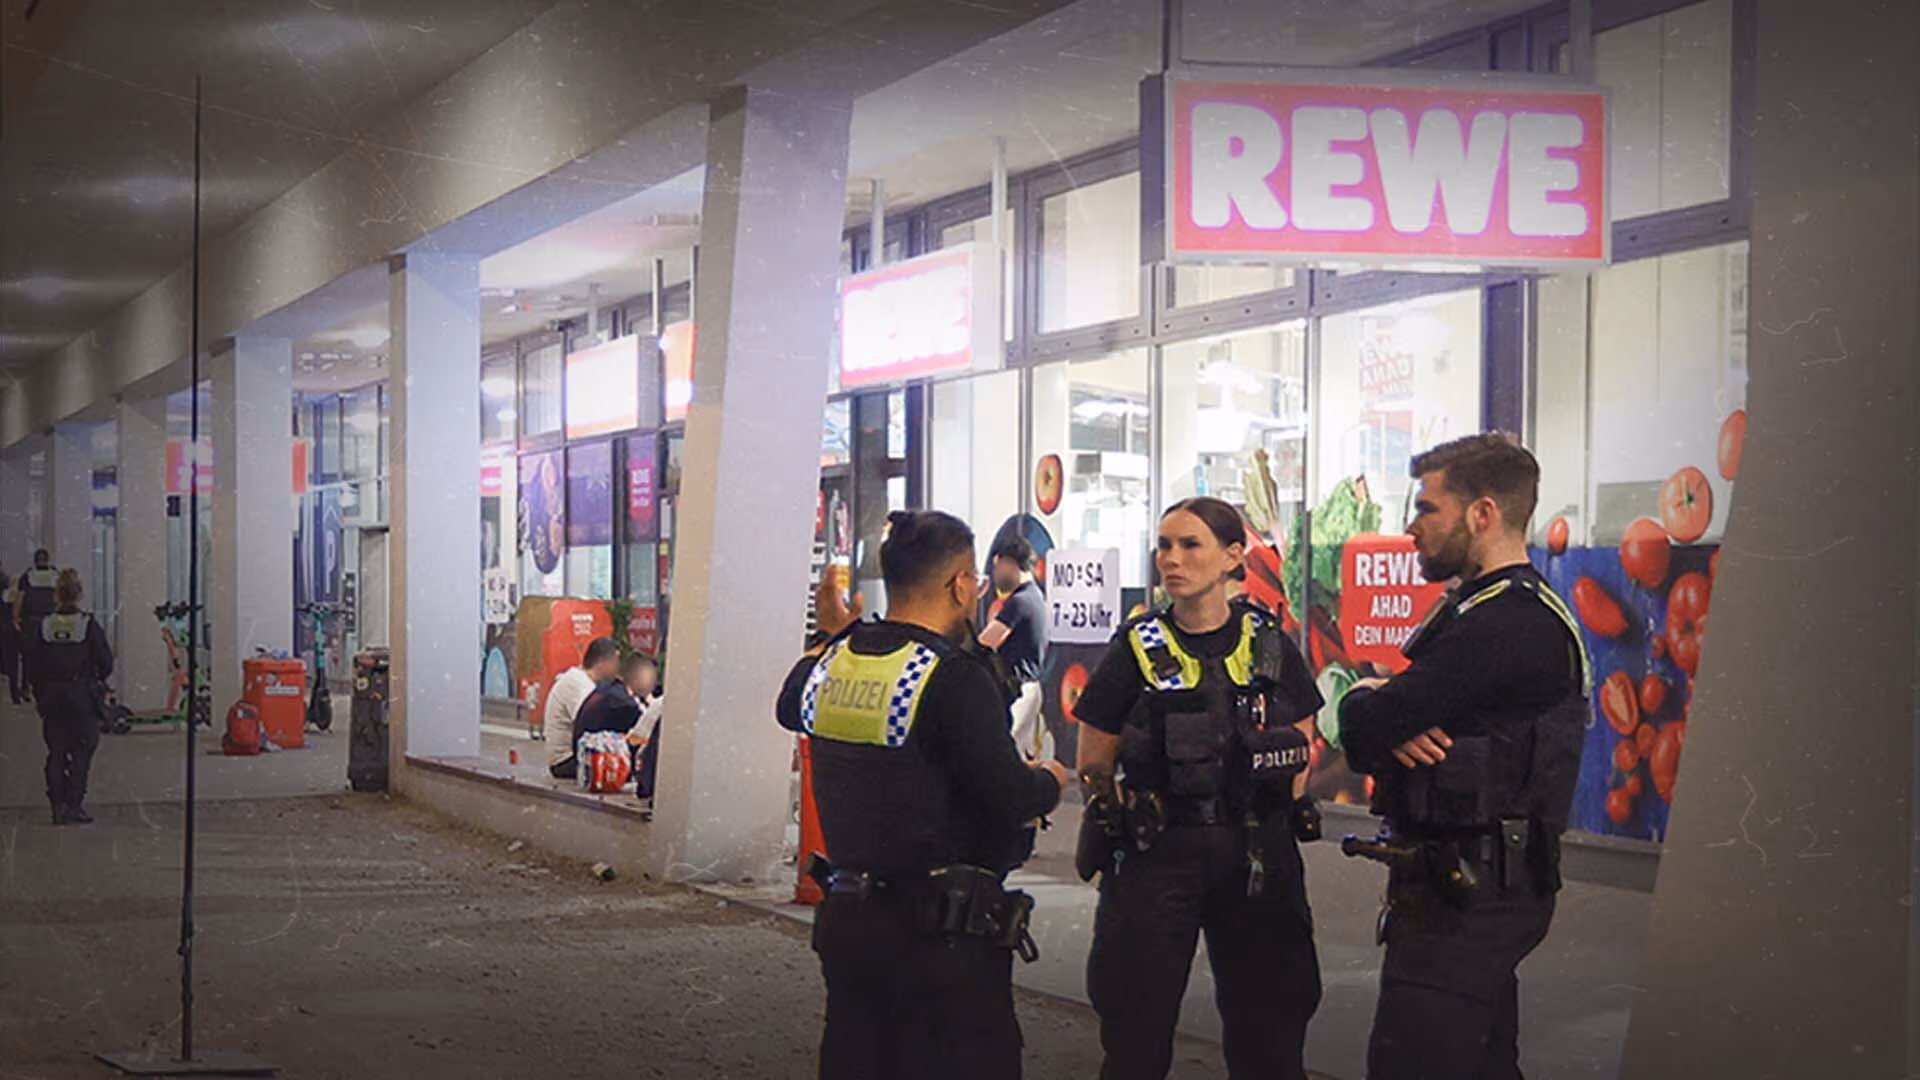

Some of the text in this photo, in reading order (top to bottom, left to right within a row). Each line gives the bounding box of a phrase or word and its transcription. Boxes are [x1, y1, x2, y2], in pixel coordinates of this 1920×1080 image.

[1189, 101, 1589, 236] REWE
[1053, 563, 1075, 588] MO
[1085, 562, 1104, 588] SA
[1355, 551, 1428, 586] REWE
[1089, 603, 1112, 627] Uhr
[1370, 594, 1412, 618] AHAD
[1354, 624, 1413, 646] DEIN MAR
[821, 677, 888, 710] POLIZEI
